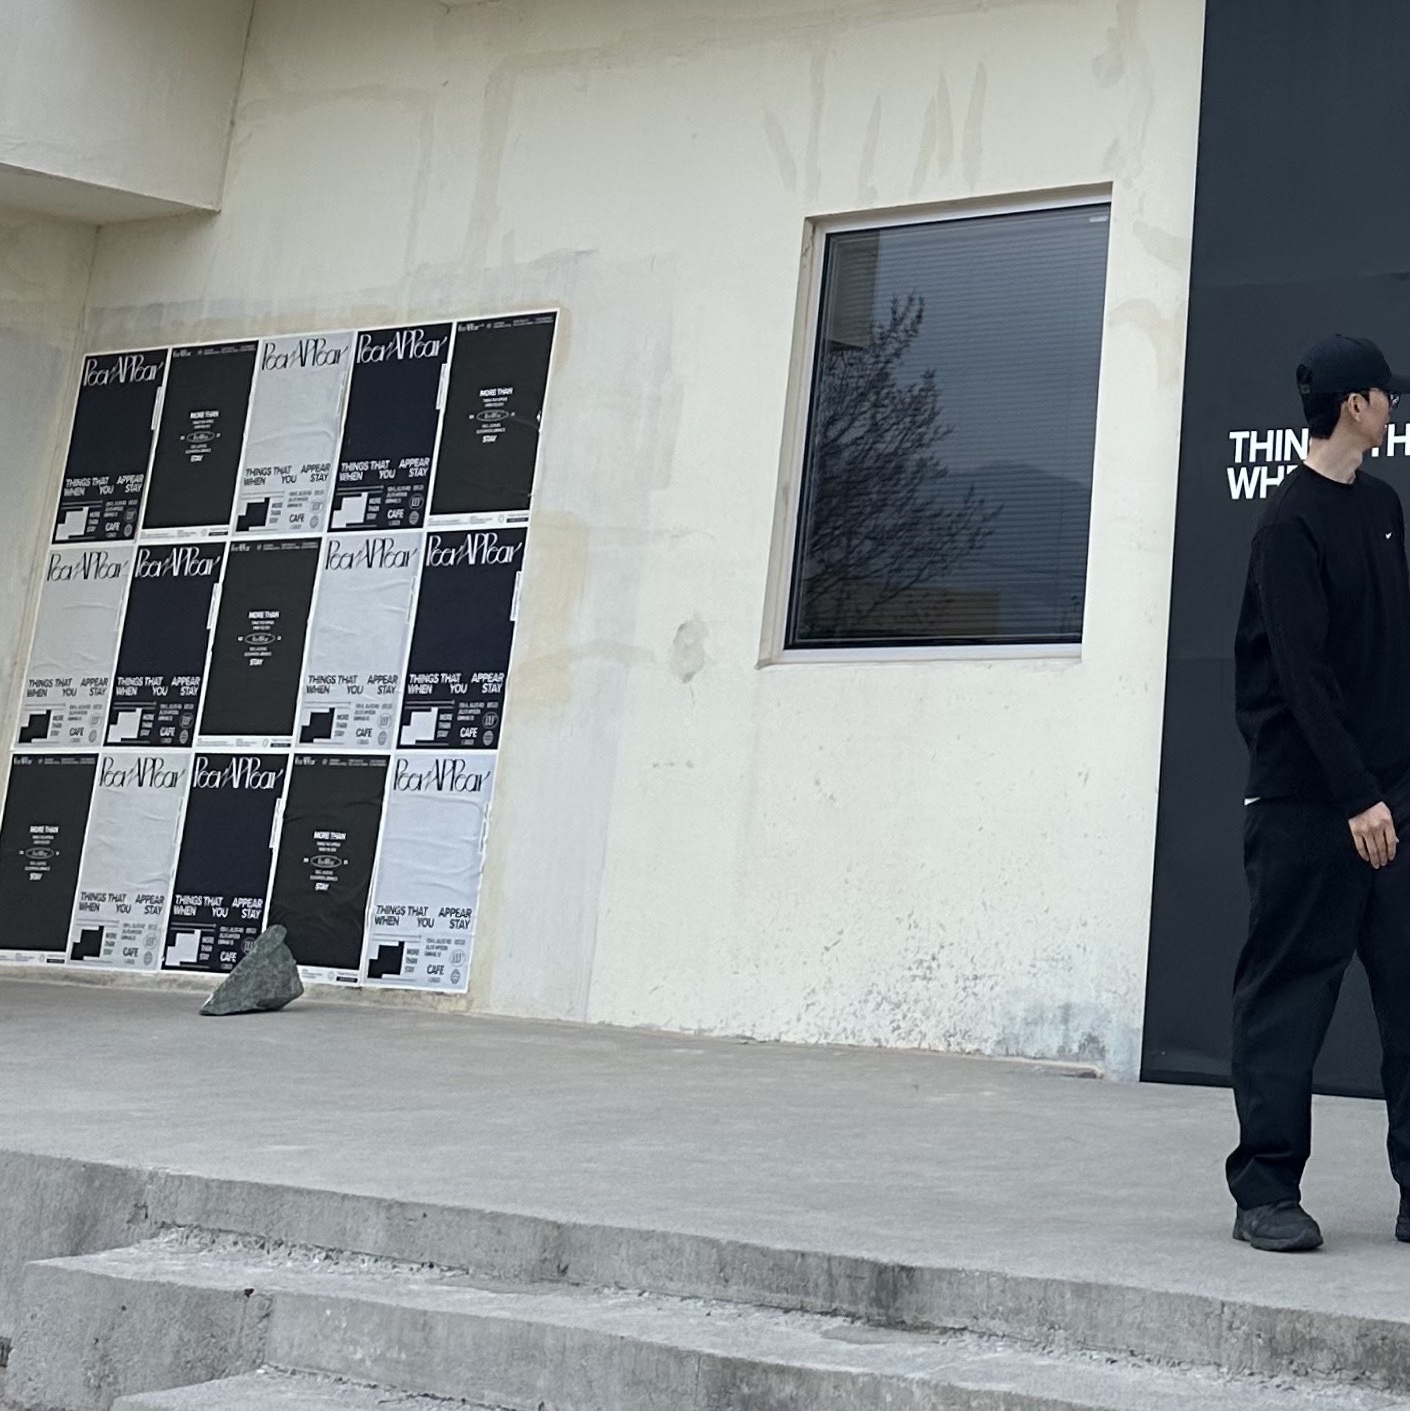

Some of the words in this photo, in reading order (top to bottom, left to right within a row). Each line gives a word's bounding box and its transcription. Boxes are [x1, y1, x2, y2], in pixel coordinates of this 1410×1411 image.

[1229, 428, 1311, 463] THIN
[245, 467, 271, 476] THINGS
[273, 465, 291, 475] THAT
[300, 463, 330, 473] APPEAR
[370, 460, 389, 469] THAT
[379, 469, 395, 479] YOU
[408, 467, 428, 477] STAY
[243, 477, 265, 486] WHEN
[281, 475, 297, 484] YOU
[309, 473, 328, 482] STAY
[289, 513, 305, 523] CAFE
[55, 678, 73, 687] THAT
[309, 675, 336, 684] THINGS
[338, 675, 358, 684] THAT
[367, 675, 399, 684] APPEAR
[410, 673, 439, 683] THINGS
[440, 673, 461, 683] THAT
[471, 672, 504, 682] APPEAR
[62, 687, 77, 697] YOU
[89, 687, 106, 696] STAY
[153, 686, 168, 695] YOU
[307, 685, 330, 694] WHEN
[347, 685, 363, 694] YOU
[377, 685, 397, 695] STAY
[408, 684, 432, 693] WHEN
[450, 683, 467, 693] YOU
[482, 683, 502, 693] STAY
[355, 728, 372, 737] CAFE
[460, 727, 477, 737] CAFE
[81, 892, 106, 902] THINGS
[108, 893, 127, 903] THAT
[135, 894, 164, 904] APPEAR
[204, 896, 223, 906] THAT
[79, 902, 100, 912] WHEN
[116, 904, 131, 914] YOU
[144, 905, 162, 915] STAY
[212, 907, 228, 917] YOU
[242, 908, 261, 918] STAY
[376, 904, 406, 916] THINGS
[407, 906, 428, 916] THAT
[438, 907, 472, 918] APPEAR
[375, 916, 399, 926] WHEN
[417, 917, 434, 928] YOU
[449, 918, 470, 929] STAY
[123, 947, 138, 957] CAFE
[427, 964, 444, 975] CAFE
